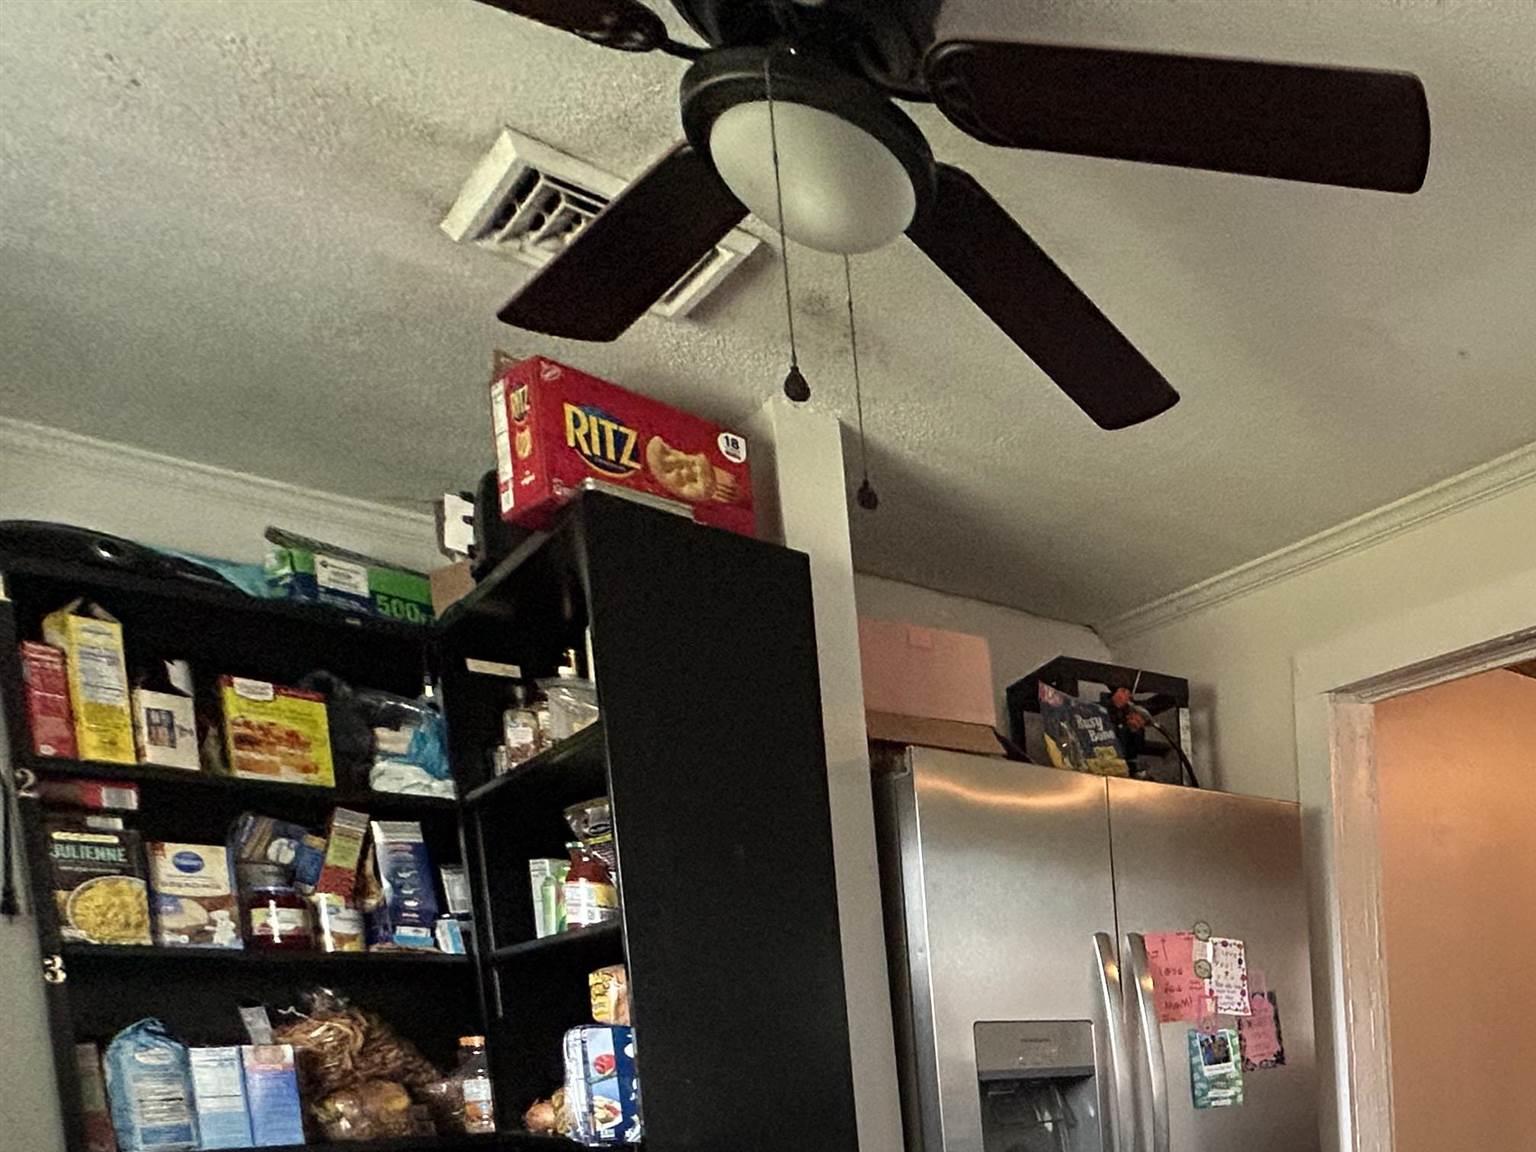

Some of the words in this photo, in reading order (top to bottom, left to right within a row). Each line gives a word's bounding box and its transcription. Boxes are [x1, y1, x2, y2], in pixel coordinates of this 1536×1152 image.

[563, 402, 642, 470] RITZ
[724, 435, 740, 450] 18
[43, 954, 67, 984] 3
